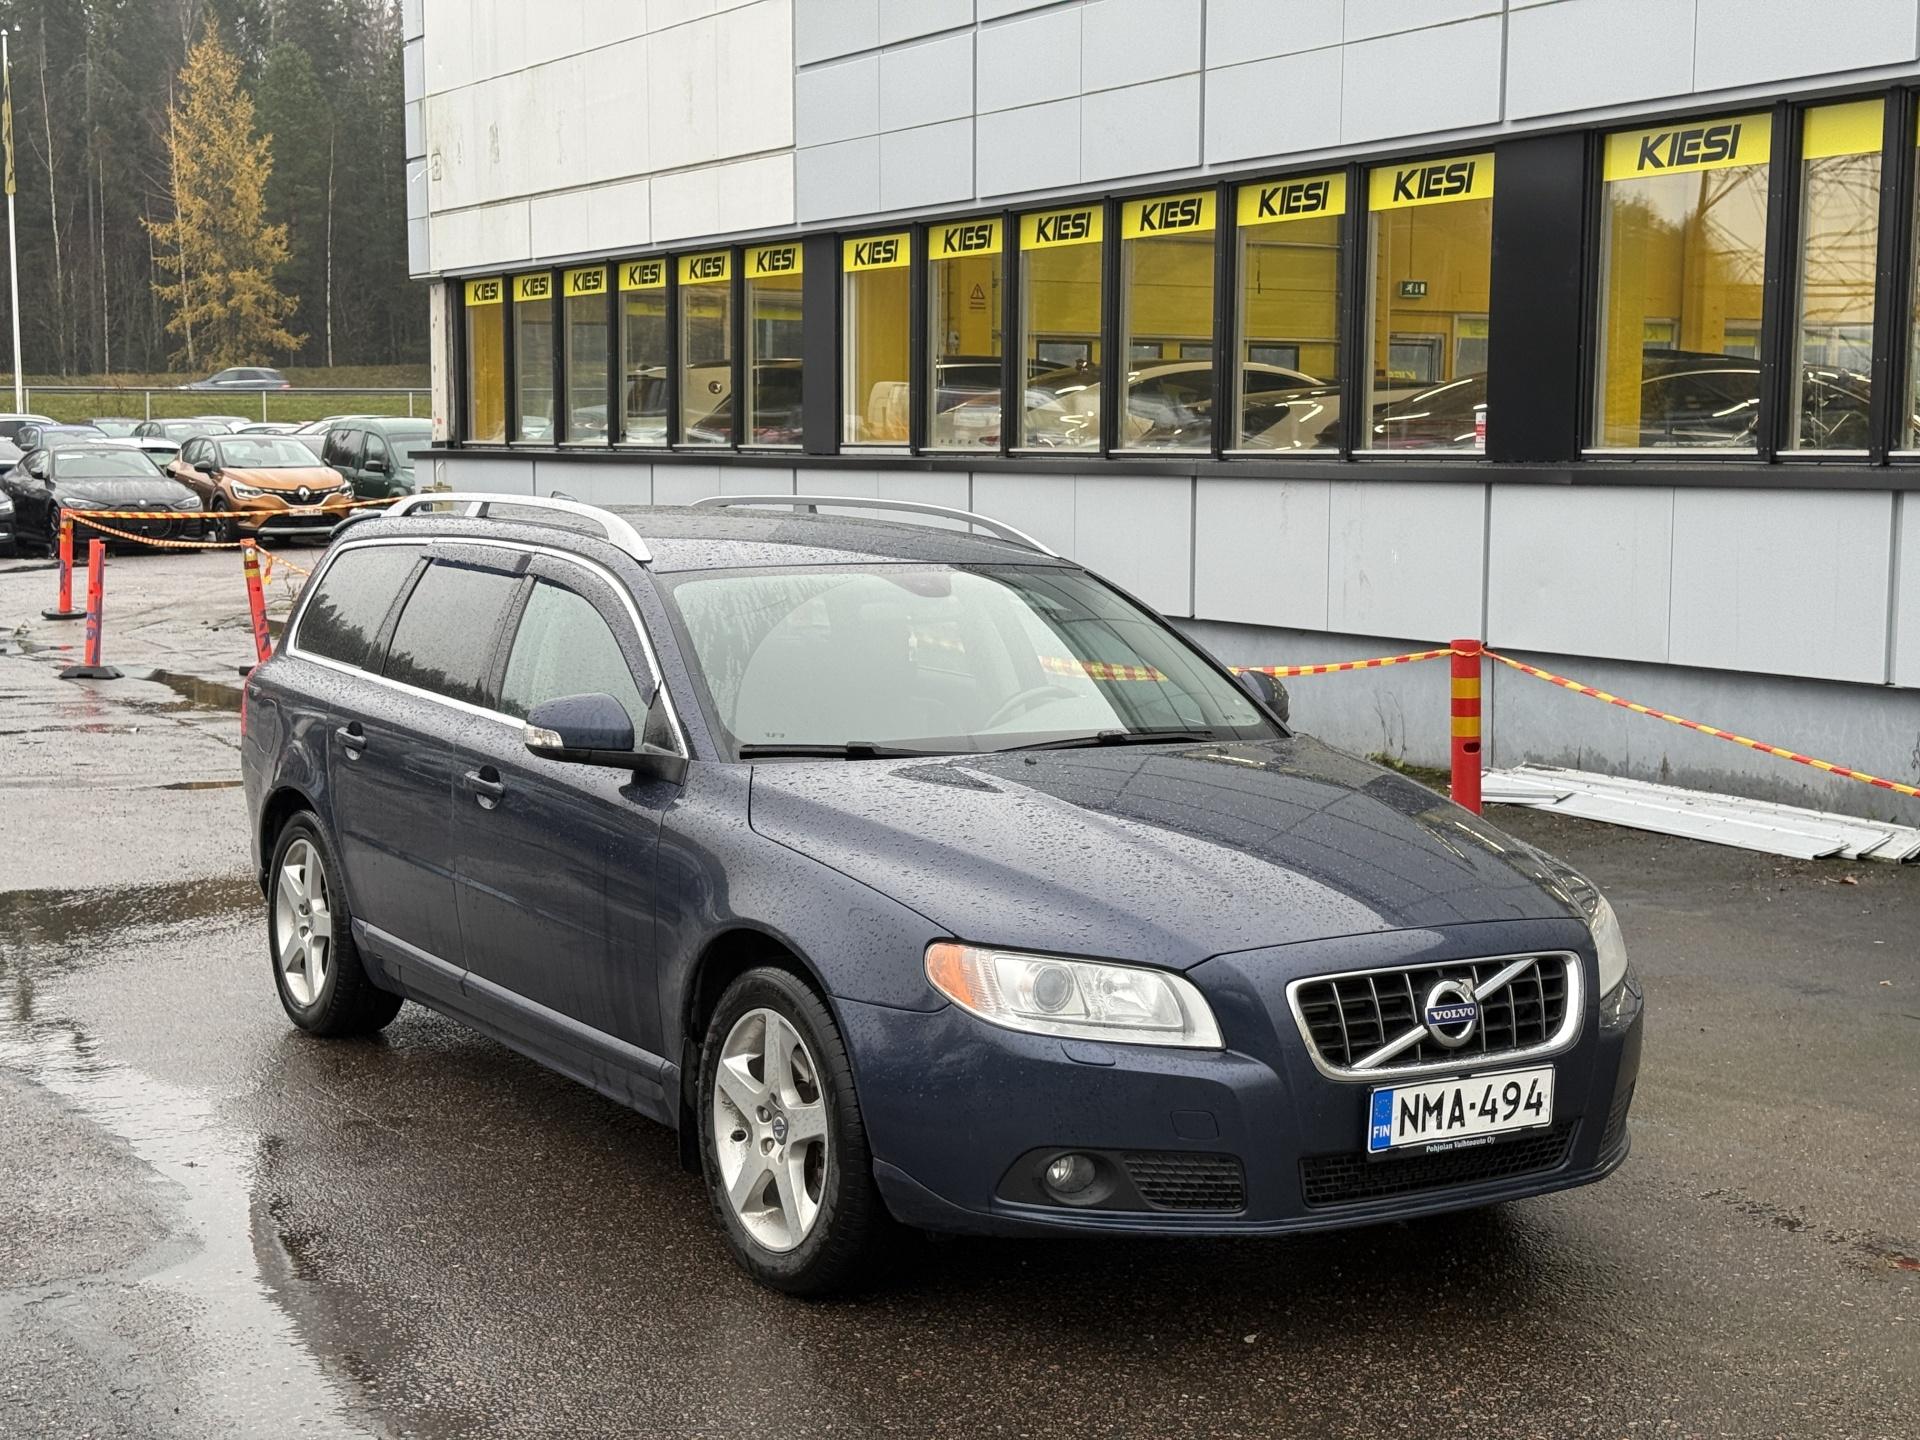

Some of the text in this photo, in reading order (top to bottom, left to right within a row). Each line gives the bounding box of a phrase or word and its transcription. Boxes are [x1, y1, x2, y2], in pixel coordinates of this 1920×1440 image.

[1637, 124, 1741, 170] KIESI
[1392, 161, 1475, 201] KIESI
[1258, 180, 1330, 217] KIESI
[1139, 198, 1202, 231] KIESI
[943, 224, 993, 253] KIESI
[1036, 212, 1091, 243] KIESI
[756, 248, 796, 272] KIESI
[854, 239, 898, 266] KIESI
[628, 264, 661, 285] KIESI
[689, 256, 725, 279] KIESI
[473, 282, 499, 301] KIESI
[521, 276, 549, 296] KIESI
[572, 270, 604, 291] KIESI
[1431, 1004, 1475, 1020] VOLVO
[1399, 1078, 1544, 1137] NMA-494
[1373, 1124, 1391, 1139] FIN
[1426, 1143, 1453, 1153] Pohjolan
[1486, 1136, 1496, 1144] Oy
